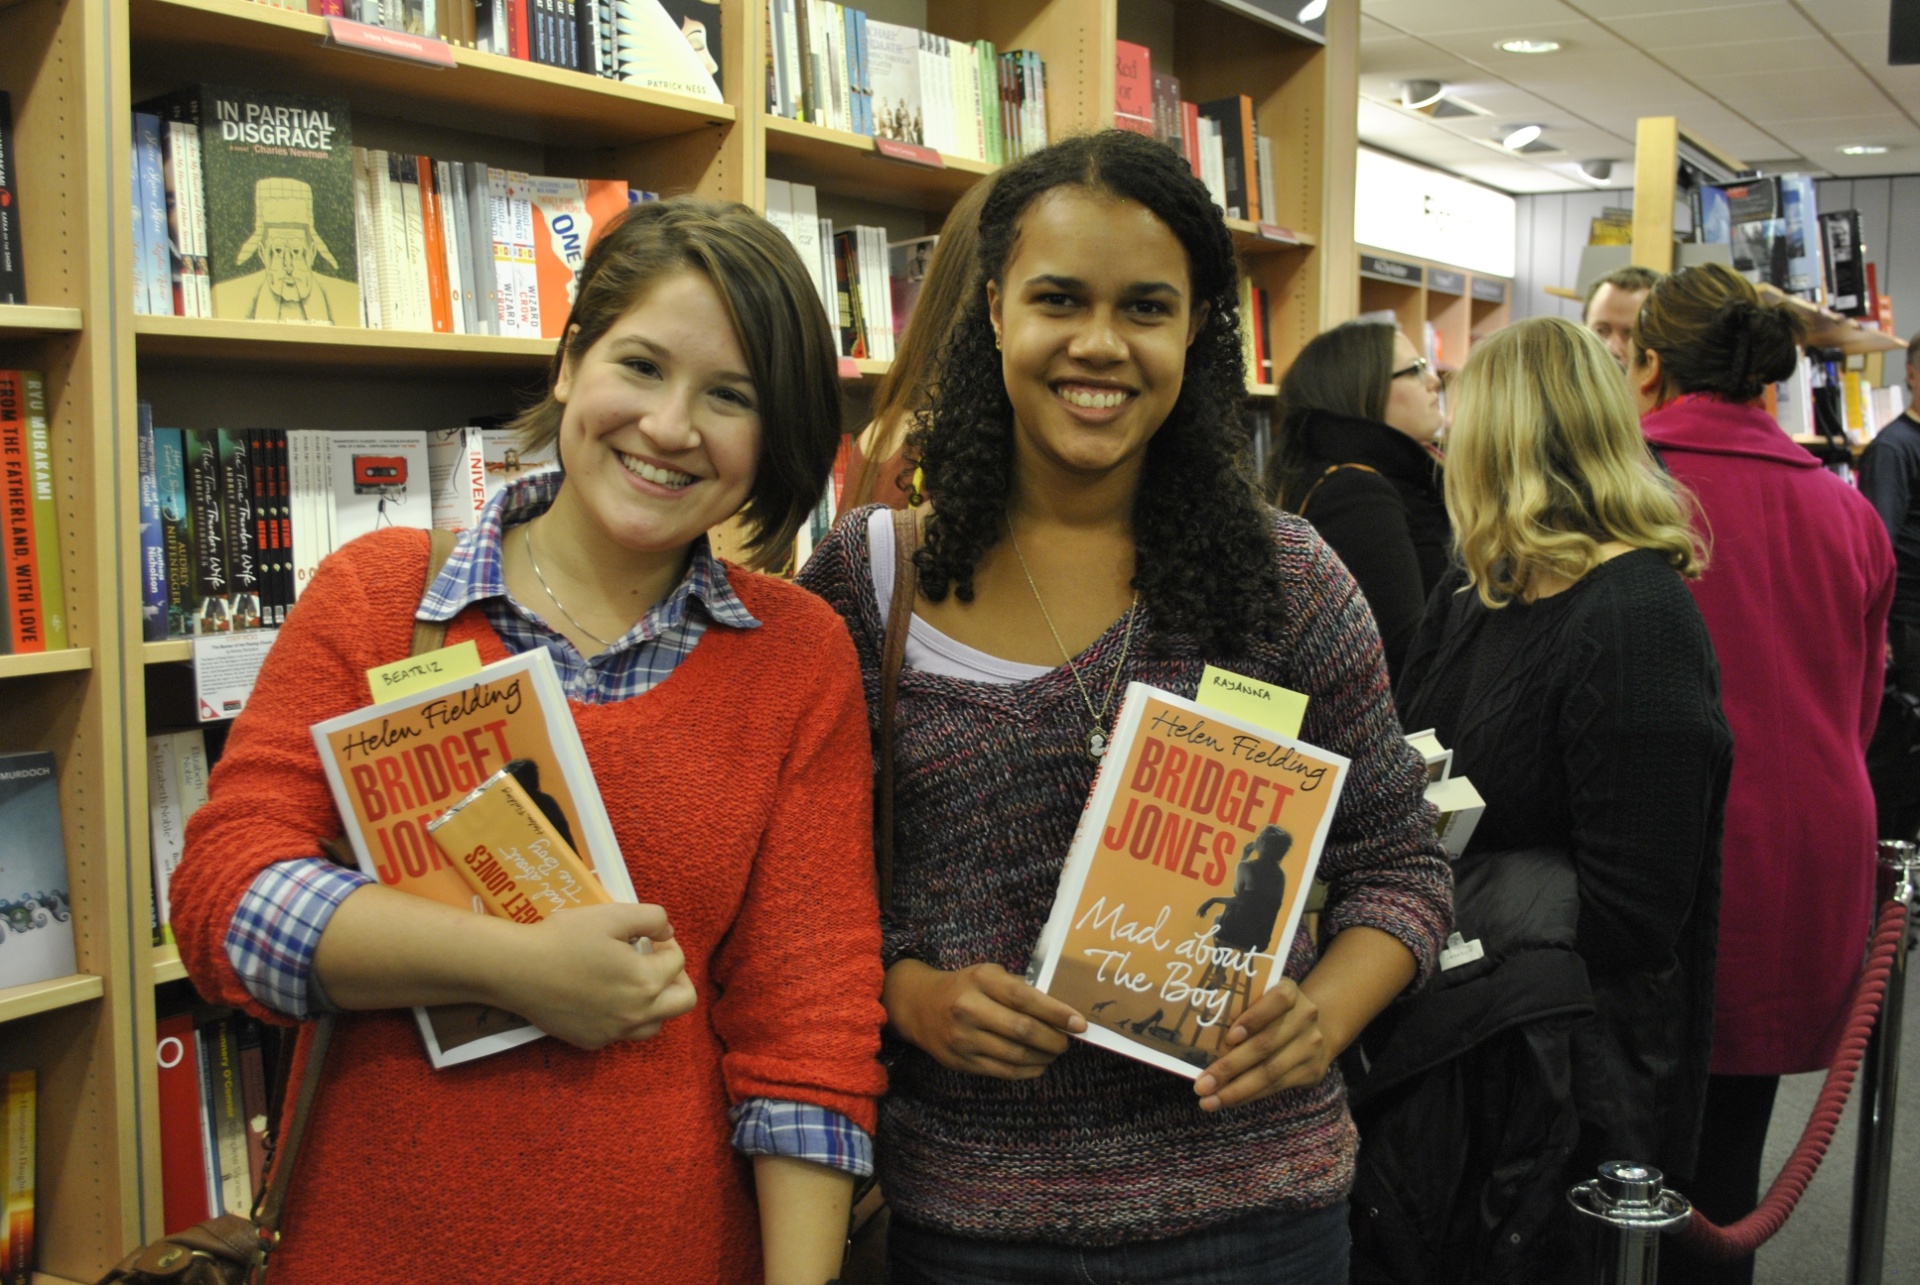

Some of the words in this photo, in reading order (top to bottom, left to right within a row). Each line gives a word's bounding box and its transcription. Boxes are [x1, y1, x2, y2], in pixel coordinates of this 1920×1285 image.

[568, 3, 576, 17] CAT
[646, 79, 682, 92] PATRICK
[684, 83, 708, 95] NESS
[215, 100, 239, 122] IN
[246, 102, 336, 132] PARTIAL
[222, 121, 333, 150] DISGRACE
[254, 144, 288, 157] Charles
[290, 147, 329, 160] Newman
[551, 213, 582, 264] ONE
[497, 289, 505, 322] CROW
[504, 283, 515, 326] WIZARD
[519, 291, 529, 323] CROW
[528, 285, 539, 328] WIZARD
[0, 380, 17, 423] FROM
[27, 380, 44, 411] RYU
[3, 427, 20, 456] THE
[30, 416, 53, 502] MURAKAMI
[138, 435, 149, 473] Passing
[201, 440, 214, 471] The
[233, 439, 246, 469] The
[141, 475, 153, 508] Clouds
[194, 468, 203, 502] AUDREY
[205, 466, 217, 505] Time
[225, 466, 234, 500] AUDREY
[236, 465, 249, 503] Time
[470, 458, 486, 511] NIVEN
[5, 461, 30, 562] FATHERLAND,
[15, 564, 34, 603] WITH
[147, 546, 158, 594] Nicholson
[167, 525, 181, 605] NIFFENEGGER
[177, 541, 189, 588] AUDREY
[203, 556, 226, 591] Wife
[235, 554, 257, 588] Wife
[19, 607, 38, 644] LOVE
[381, 661, 444, 687] BEATRIZ
[1212, 675, 1272, 702] RAYANNA
[342, 719, 422, 762] Helen
[421, 677, 523, 730] Fielding
[191, 746, 204, 790] Elizabeth
[1151, 709, 1225, 753] Helen
[1232, 733, 1329, 792] Fielding
[0, 766, 51, 781] MURDOCH
[155, 754, 169, 804] Elizabeth
[182, 756, 193, 786] Noble
[350, 719, 513, 824] BRIDGET
[1129, 736, 1296, 834] BRIDGET
[501, 786, 528, 817] Fielding
[160, 805, 173, 839] Noble
[527, 813, 545, 836] Helen
[528, 838, 560, 877] Boy
[1102, 797, 1237, 887] JONES
[463, 844, 516, 898] JONES
[498, 846, 542, 882] about
[559, 869, 583, 904] The
[1075, 896, 1171, 953] Mad
[1174, 923, 1277, 978] about
[1083, 948, 1154, 993] The
[1159, 961, 1232, 1028] Boy
[219, 1022, 230, 1068] Flannery
[223, 1069, 235, 1118] O'Connor
[228, 1121, 239, 1165] Complete
[232, 1166, 242, 1198] Stories
